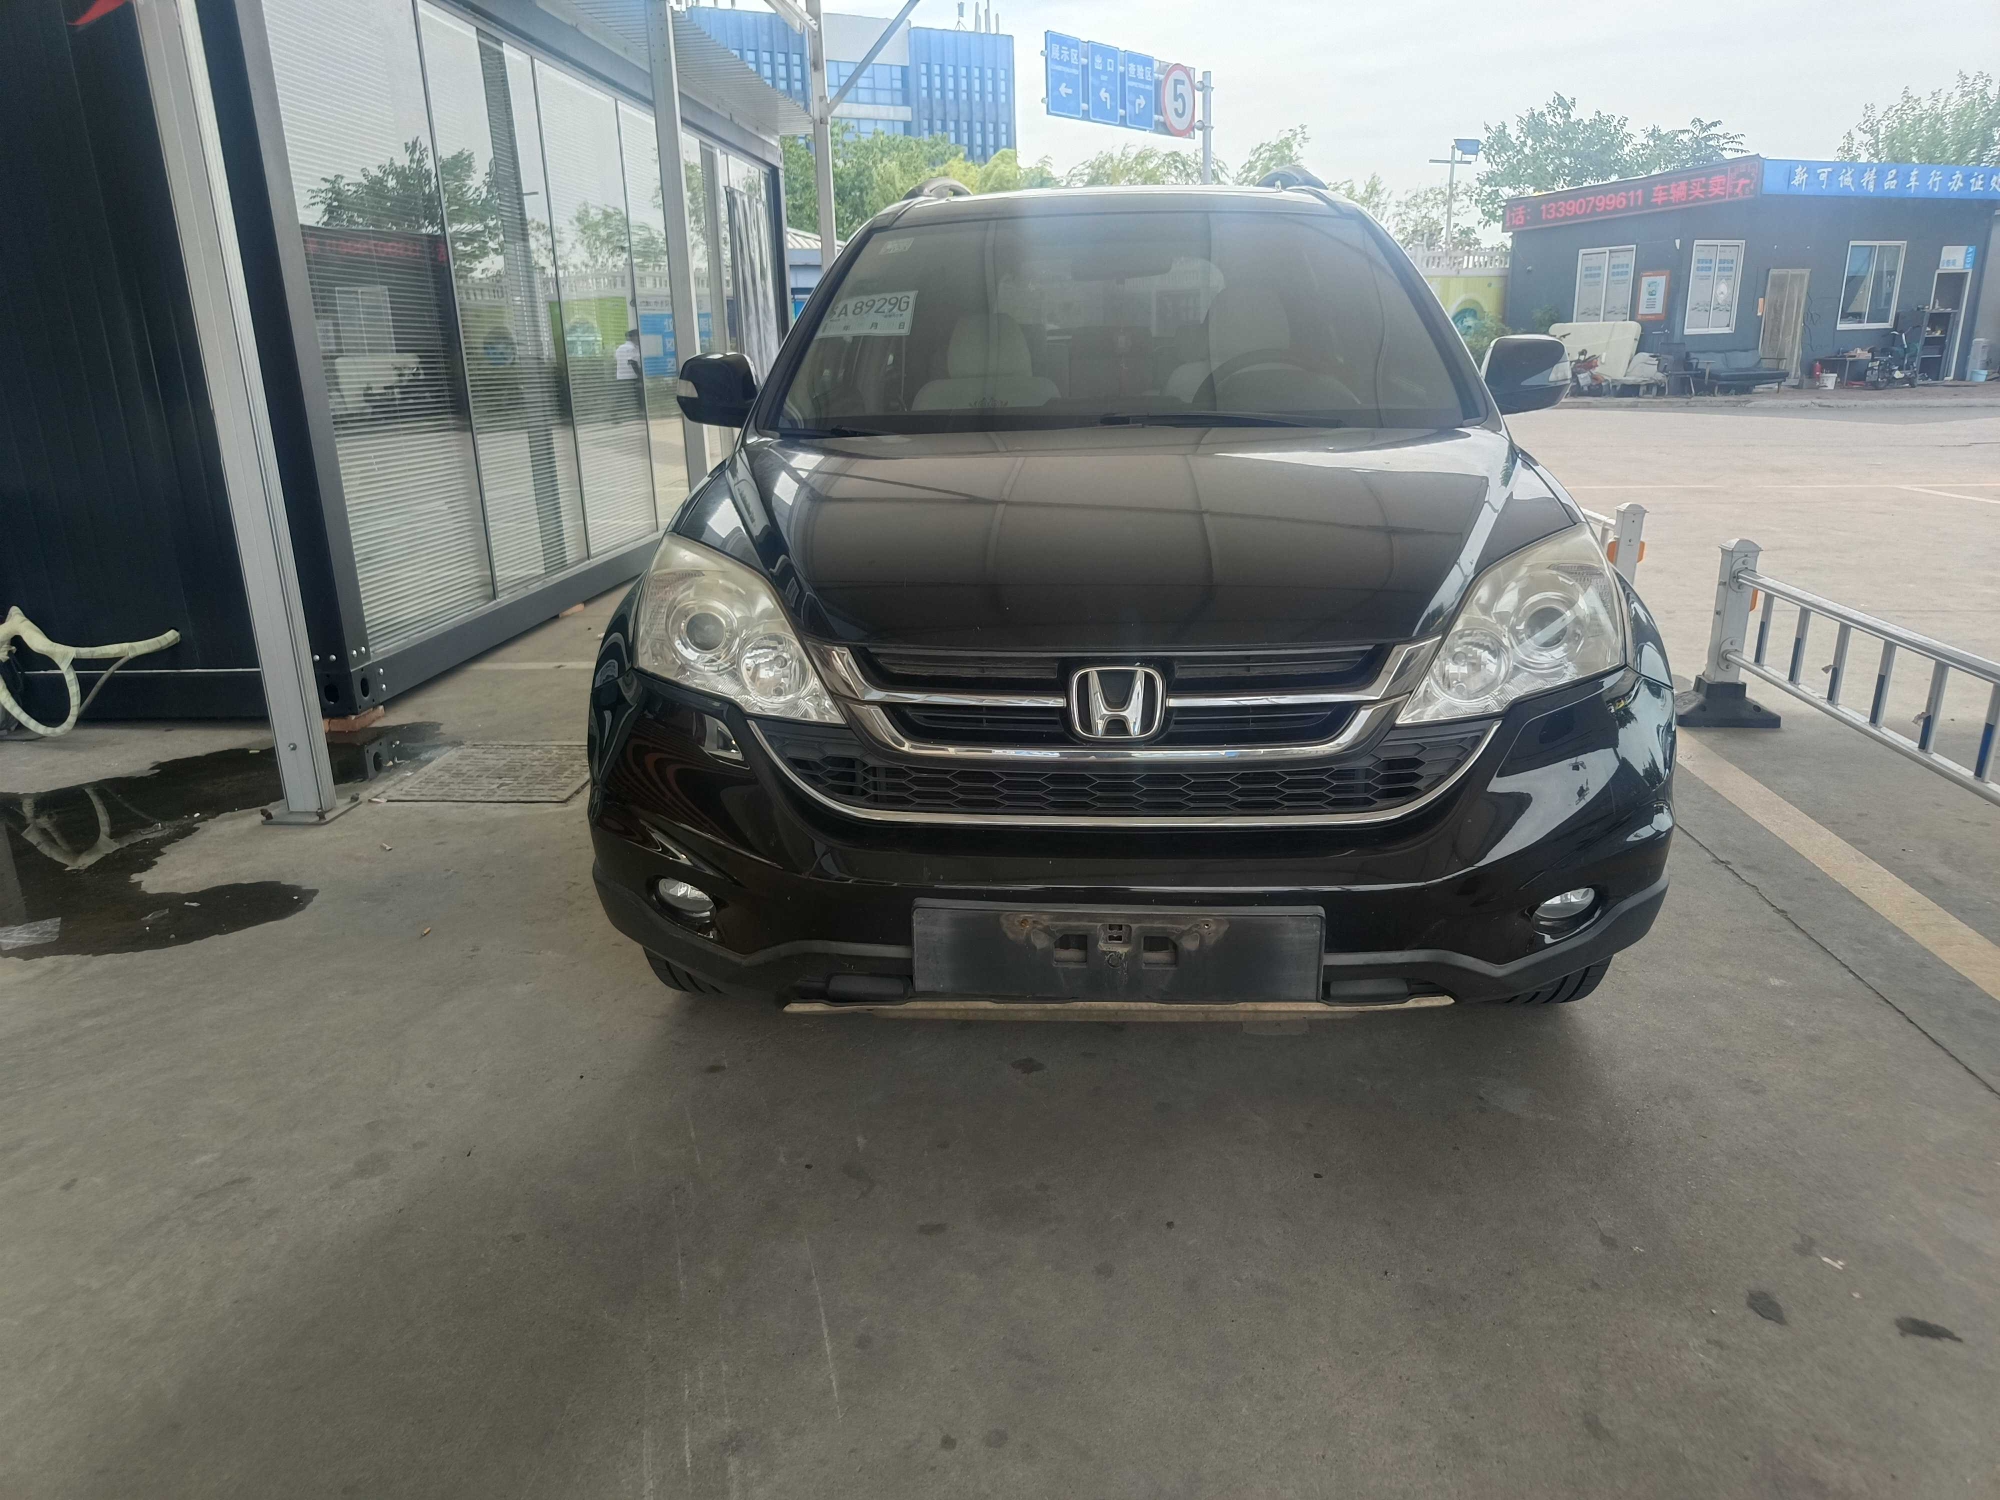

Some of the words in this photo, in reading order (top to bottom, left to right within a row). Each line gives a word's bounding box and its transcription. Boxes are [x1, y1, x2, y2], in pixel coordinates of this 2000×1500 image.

[1051, 43, 1079, 65] 展示区
[1094, 54, 1114, 72] 出口
[1173, 79, 1186, 118] 5
[1541, 189, 1643, 220] 13390799611
[1652, 174, 1727, 205] 车辆买卖
